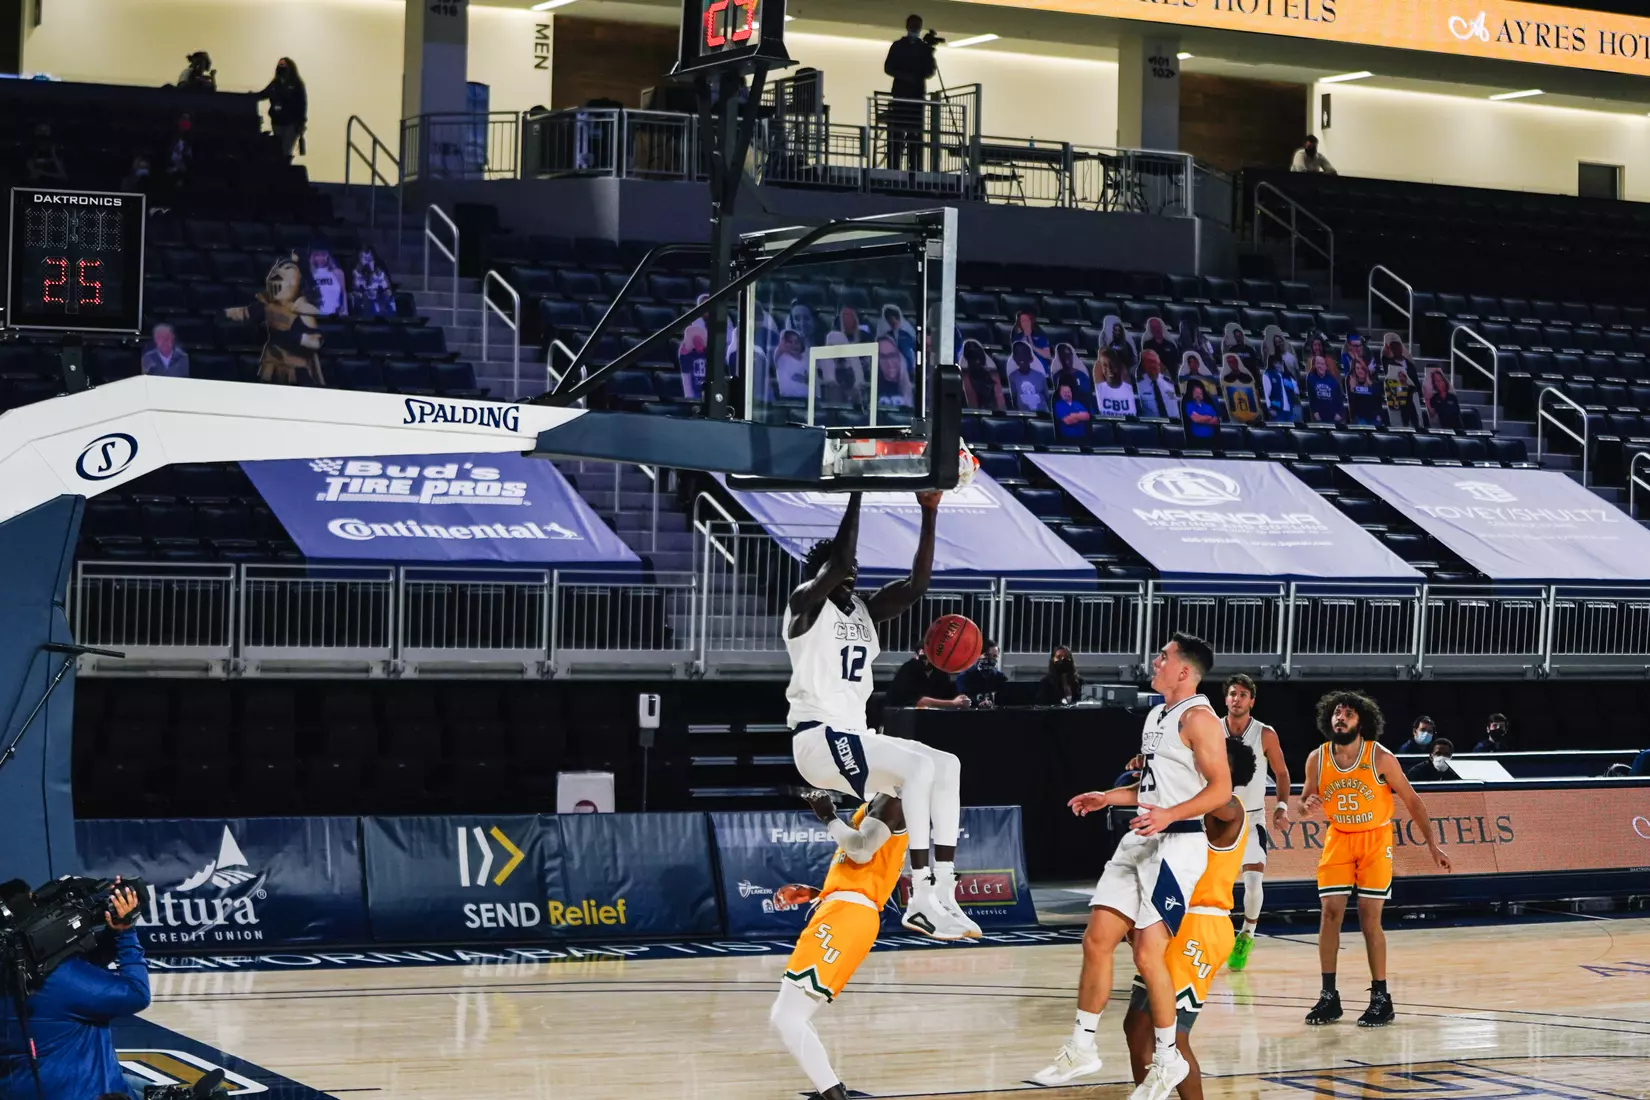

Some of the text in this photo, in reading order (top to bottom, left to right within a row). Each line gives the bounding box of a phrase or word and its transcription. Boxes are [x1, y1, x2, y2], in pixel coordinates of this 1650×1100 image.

[534, 23, 551, 70] MEN
[1496, 18, 1586, 51] AYRES
[34, 194, 122, 206] DAKTRONICS
[43, 258, 101, 304] 25
[403, 397, 520, 433] SPALDING
[1102, 398, 1129, 412] CBU
[343, 460, 501, 480] Bud's
[324, 477, 413, 502] TIRE
[1133, 508, 1321, 525] MAGNOLIA
[327, 517, 548, 541] Continental
[834, 621, 872, 642] CBU
[840, 645, 867, 682] 12
[834, 736, 860, 776] LANCERS
[1323, 778, 1375, 802] SOUTHEASTERN
[1337, 793, 1359, 811] 25
[463, 898, 627, 929] SEND Relief
[976, 908, 1008, 916] service
[150, 930, 264, 943] CREDIT UNION
[814, 923, 841, 964] SLU
[1183, 939, 1212, 979] SLU
